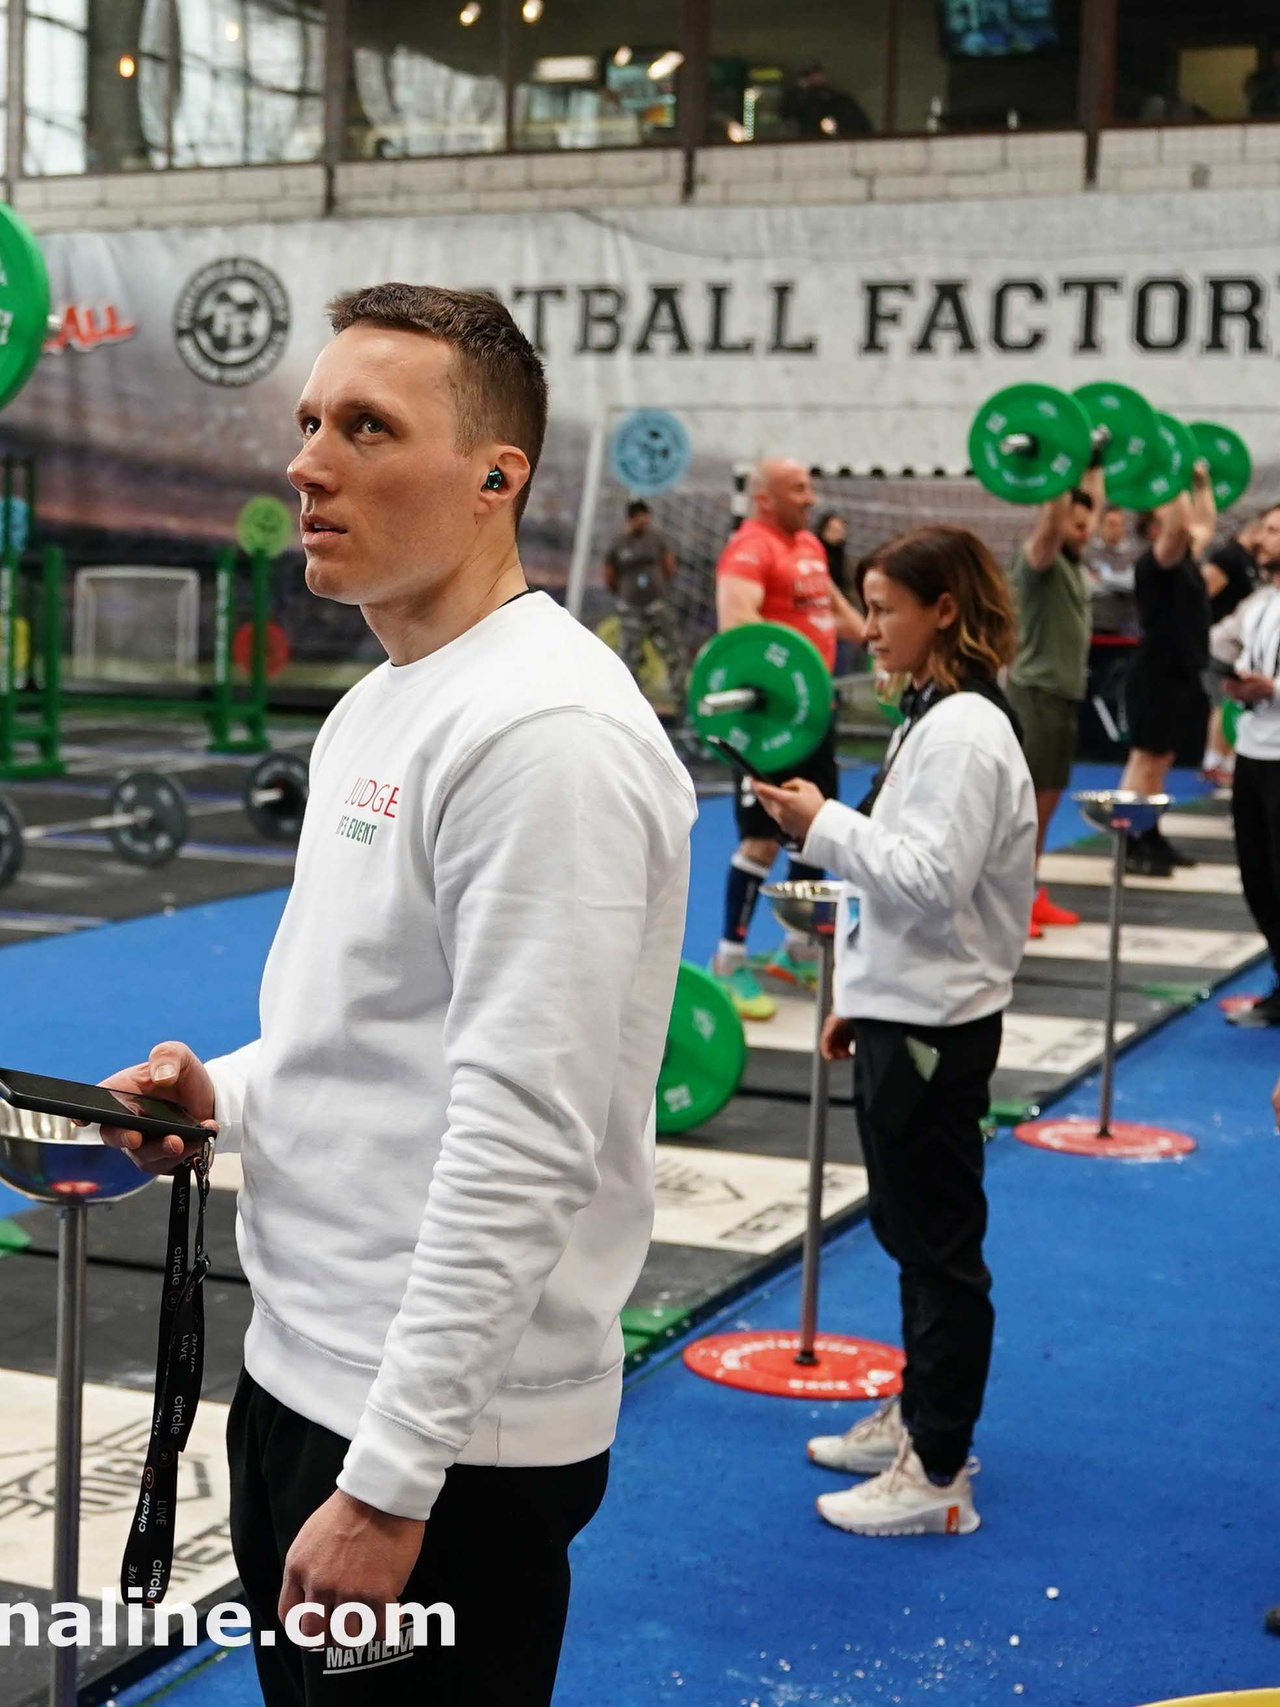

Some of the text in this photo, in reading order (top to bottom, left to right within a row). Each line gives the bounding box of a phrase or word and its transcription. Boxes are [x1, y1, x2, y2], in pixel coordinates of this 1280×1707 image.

[465, 274, 1280, 358] TBALL FACTOR
[344, 776, 400, 819] JUDGE
[346, 817, 378, 846] EVENT
[171, 1246, 184, 1286] circle
[170, 1395, 187, 1435] circle
[138, 1492, 151, 1533] circle
[155, 1500, 168, 1527] LIVE
[127, 1563, 139, 1587] IVE
[147, 1559, 166, 1598] circle
[326, 1626, 415, 1669] MAYHEM
